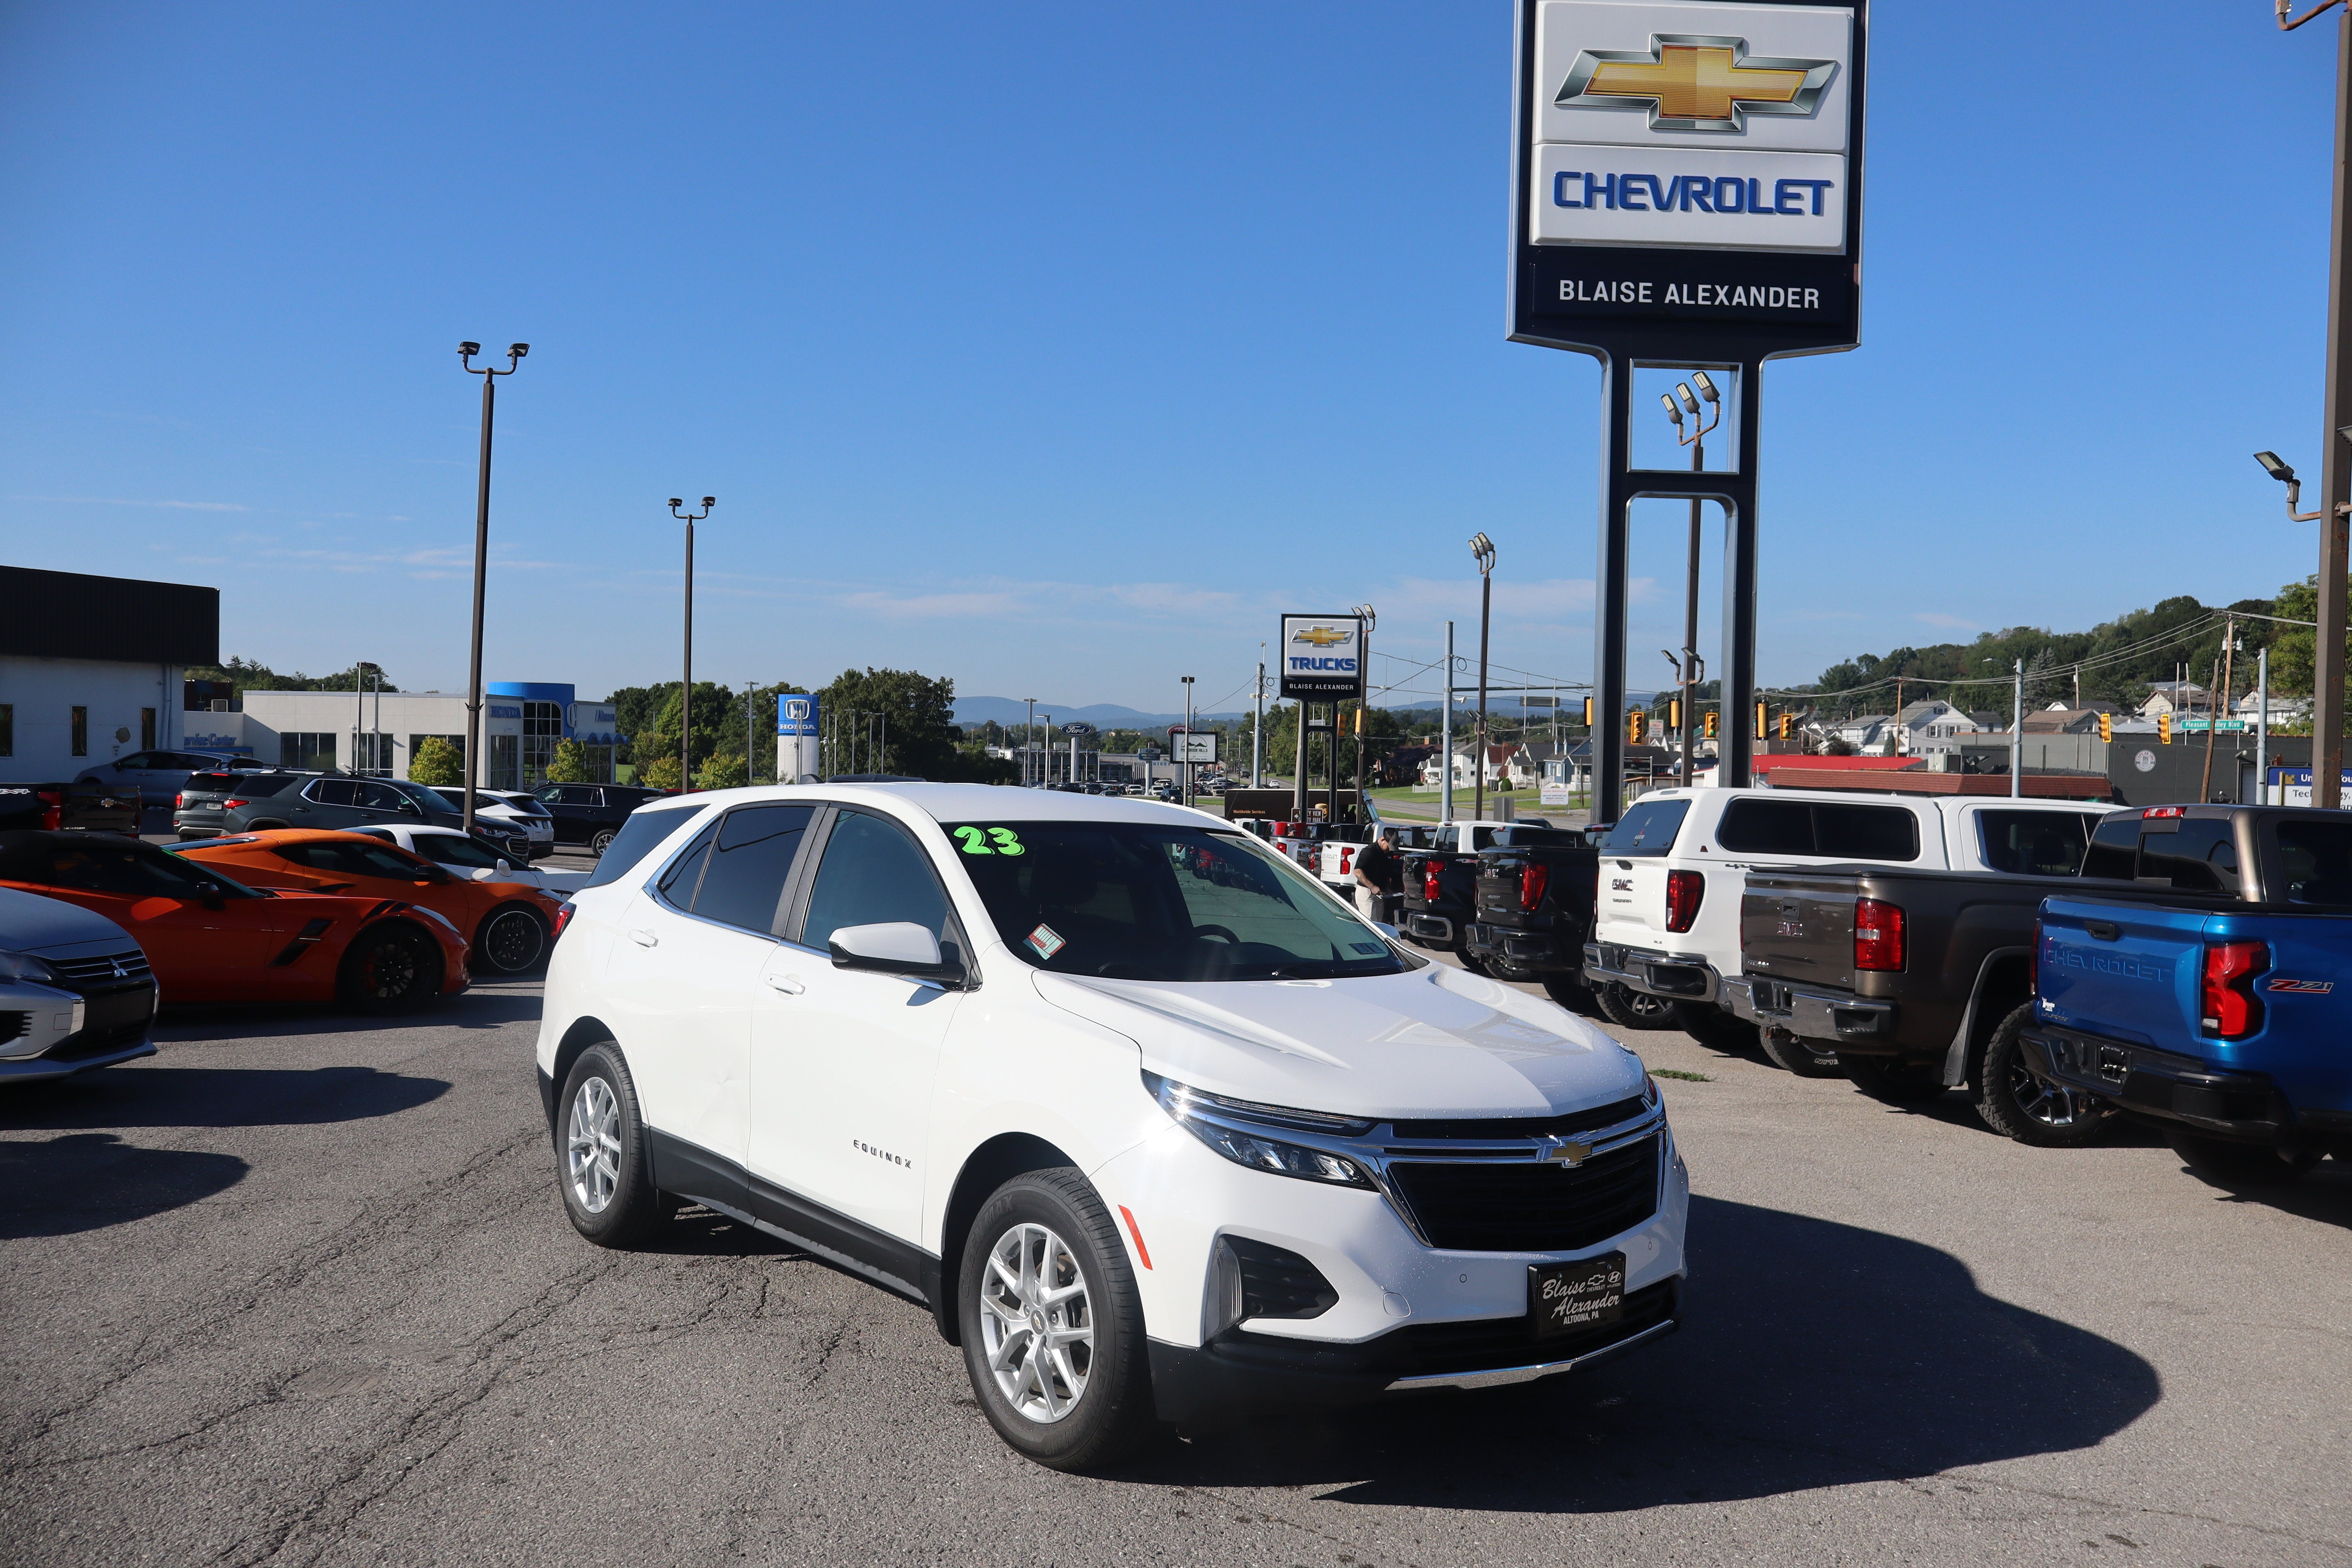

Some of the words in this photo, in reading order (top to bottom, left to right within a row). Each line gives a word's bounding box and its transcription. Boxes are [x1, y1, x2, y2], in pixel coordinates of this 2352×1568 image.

[1553, 171, 1831, 215] CHEVROLET
[1559, 279, 1653, 303] BLAISE
[1664, 283, 1819, 309] ALEXANDER
[1289, 657, 1356, 670] TRUCKS
[1066, 725, 1086, 734] Ford
[953, 826, 1025, 856] 23
[1612, 879, 1635, 892] GMC
[1777, 921, 1803, 938] GMC
[2044, 948, 2171, 982] CHEVROLET
[2266, 979, 2334, 994] Z71
[853, 1139, 911, 1169] EQUINOX
[1542, 1279, 1586, 1299] Blaise
[1587, 1284, 1606, 1292] CHEVROLET
[1551, 1290, 1619, 1319] Alexander
[1563, 1313, 1590, 1325] ALTOONA,
[1591, 1310, 1599, 1319] PA
